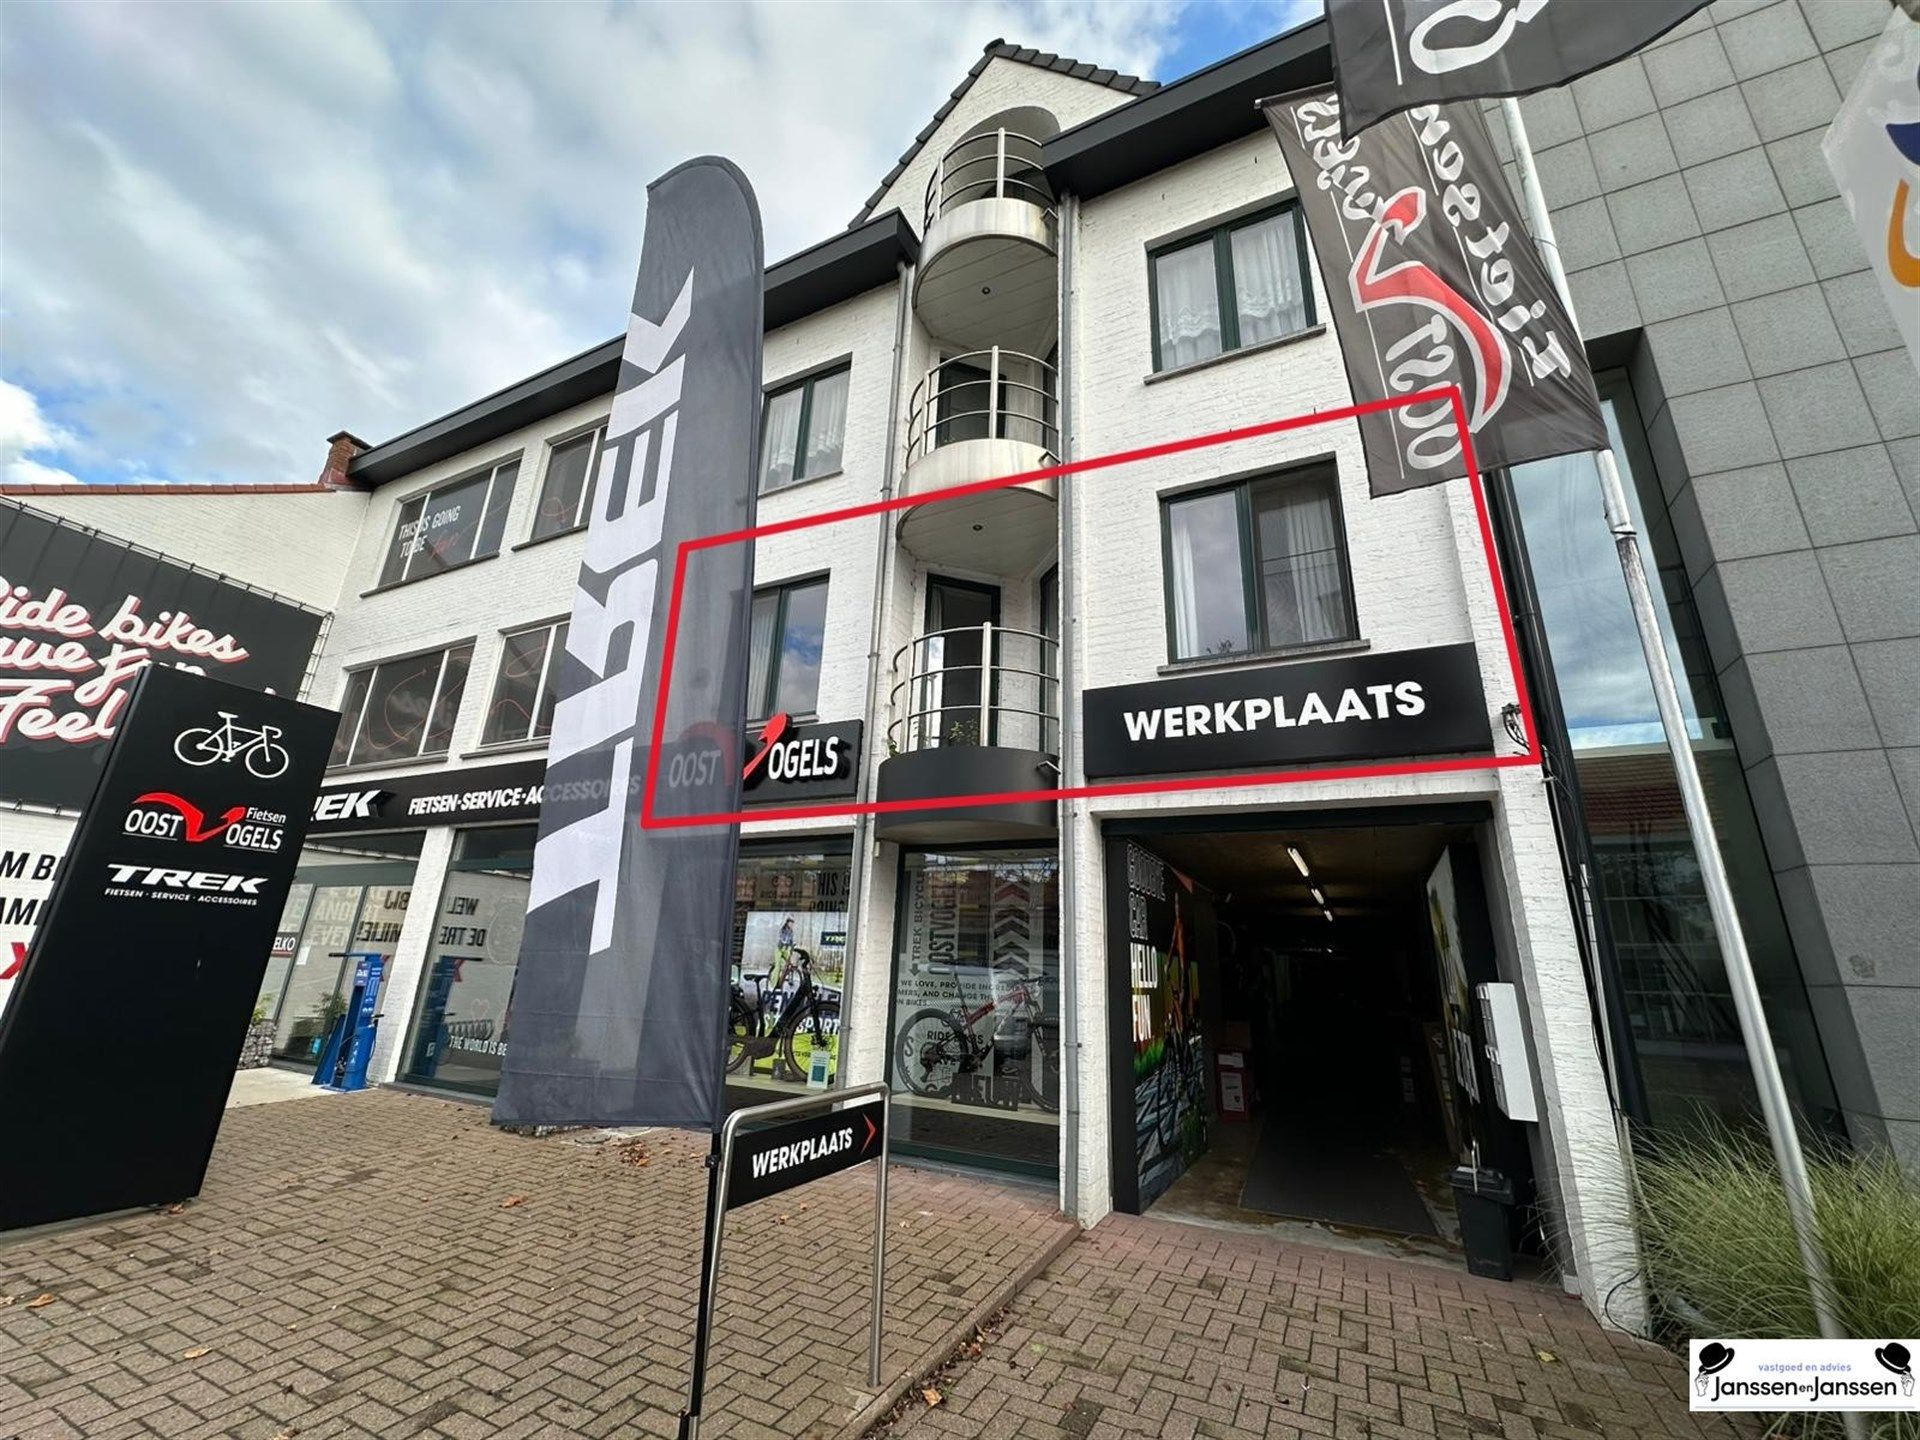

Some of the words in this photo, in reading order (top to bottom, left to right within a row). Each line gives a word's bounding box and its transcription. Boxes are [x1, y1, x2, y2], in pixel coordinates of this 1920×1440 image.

[432, 506, 461, 529] GOING
[98, 595, 250, 661] bikes
[1123, 681, 1426, 741] WERKPLAATS
[246, 807, 287, 824] Fietsen
[107, 863, 269, 894] TREK
[104, 887, 144, 898] FIETSEN
[151, 891, 190, 901] SERVICE
[197, 895, 258, 906] ACCESSOIRES
[1130, 942, 1158, 989] HELLO
[922, 990, 940, 998] AND
[752, 1127, 854, 1179] WERKPLAATS
